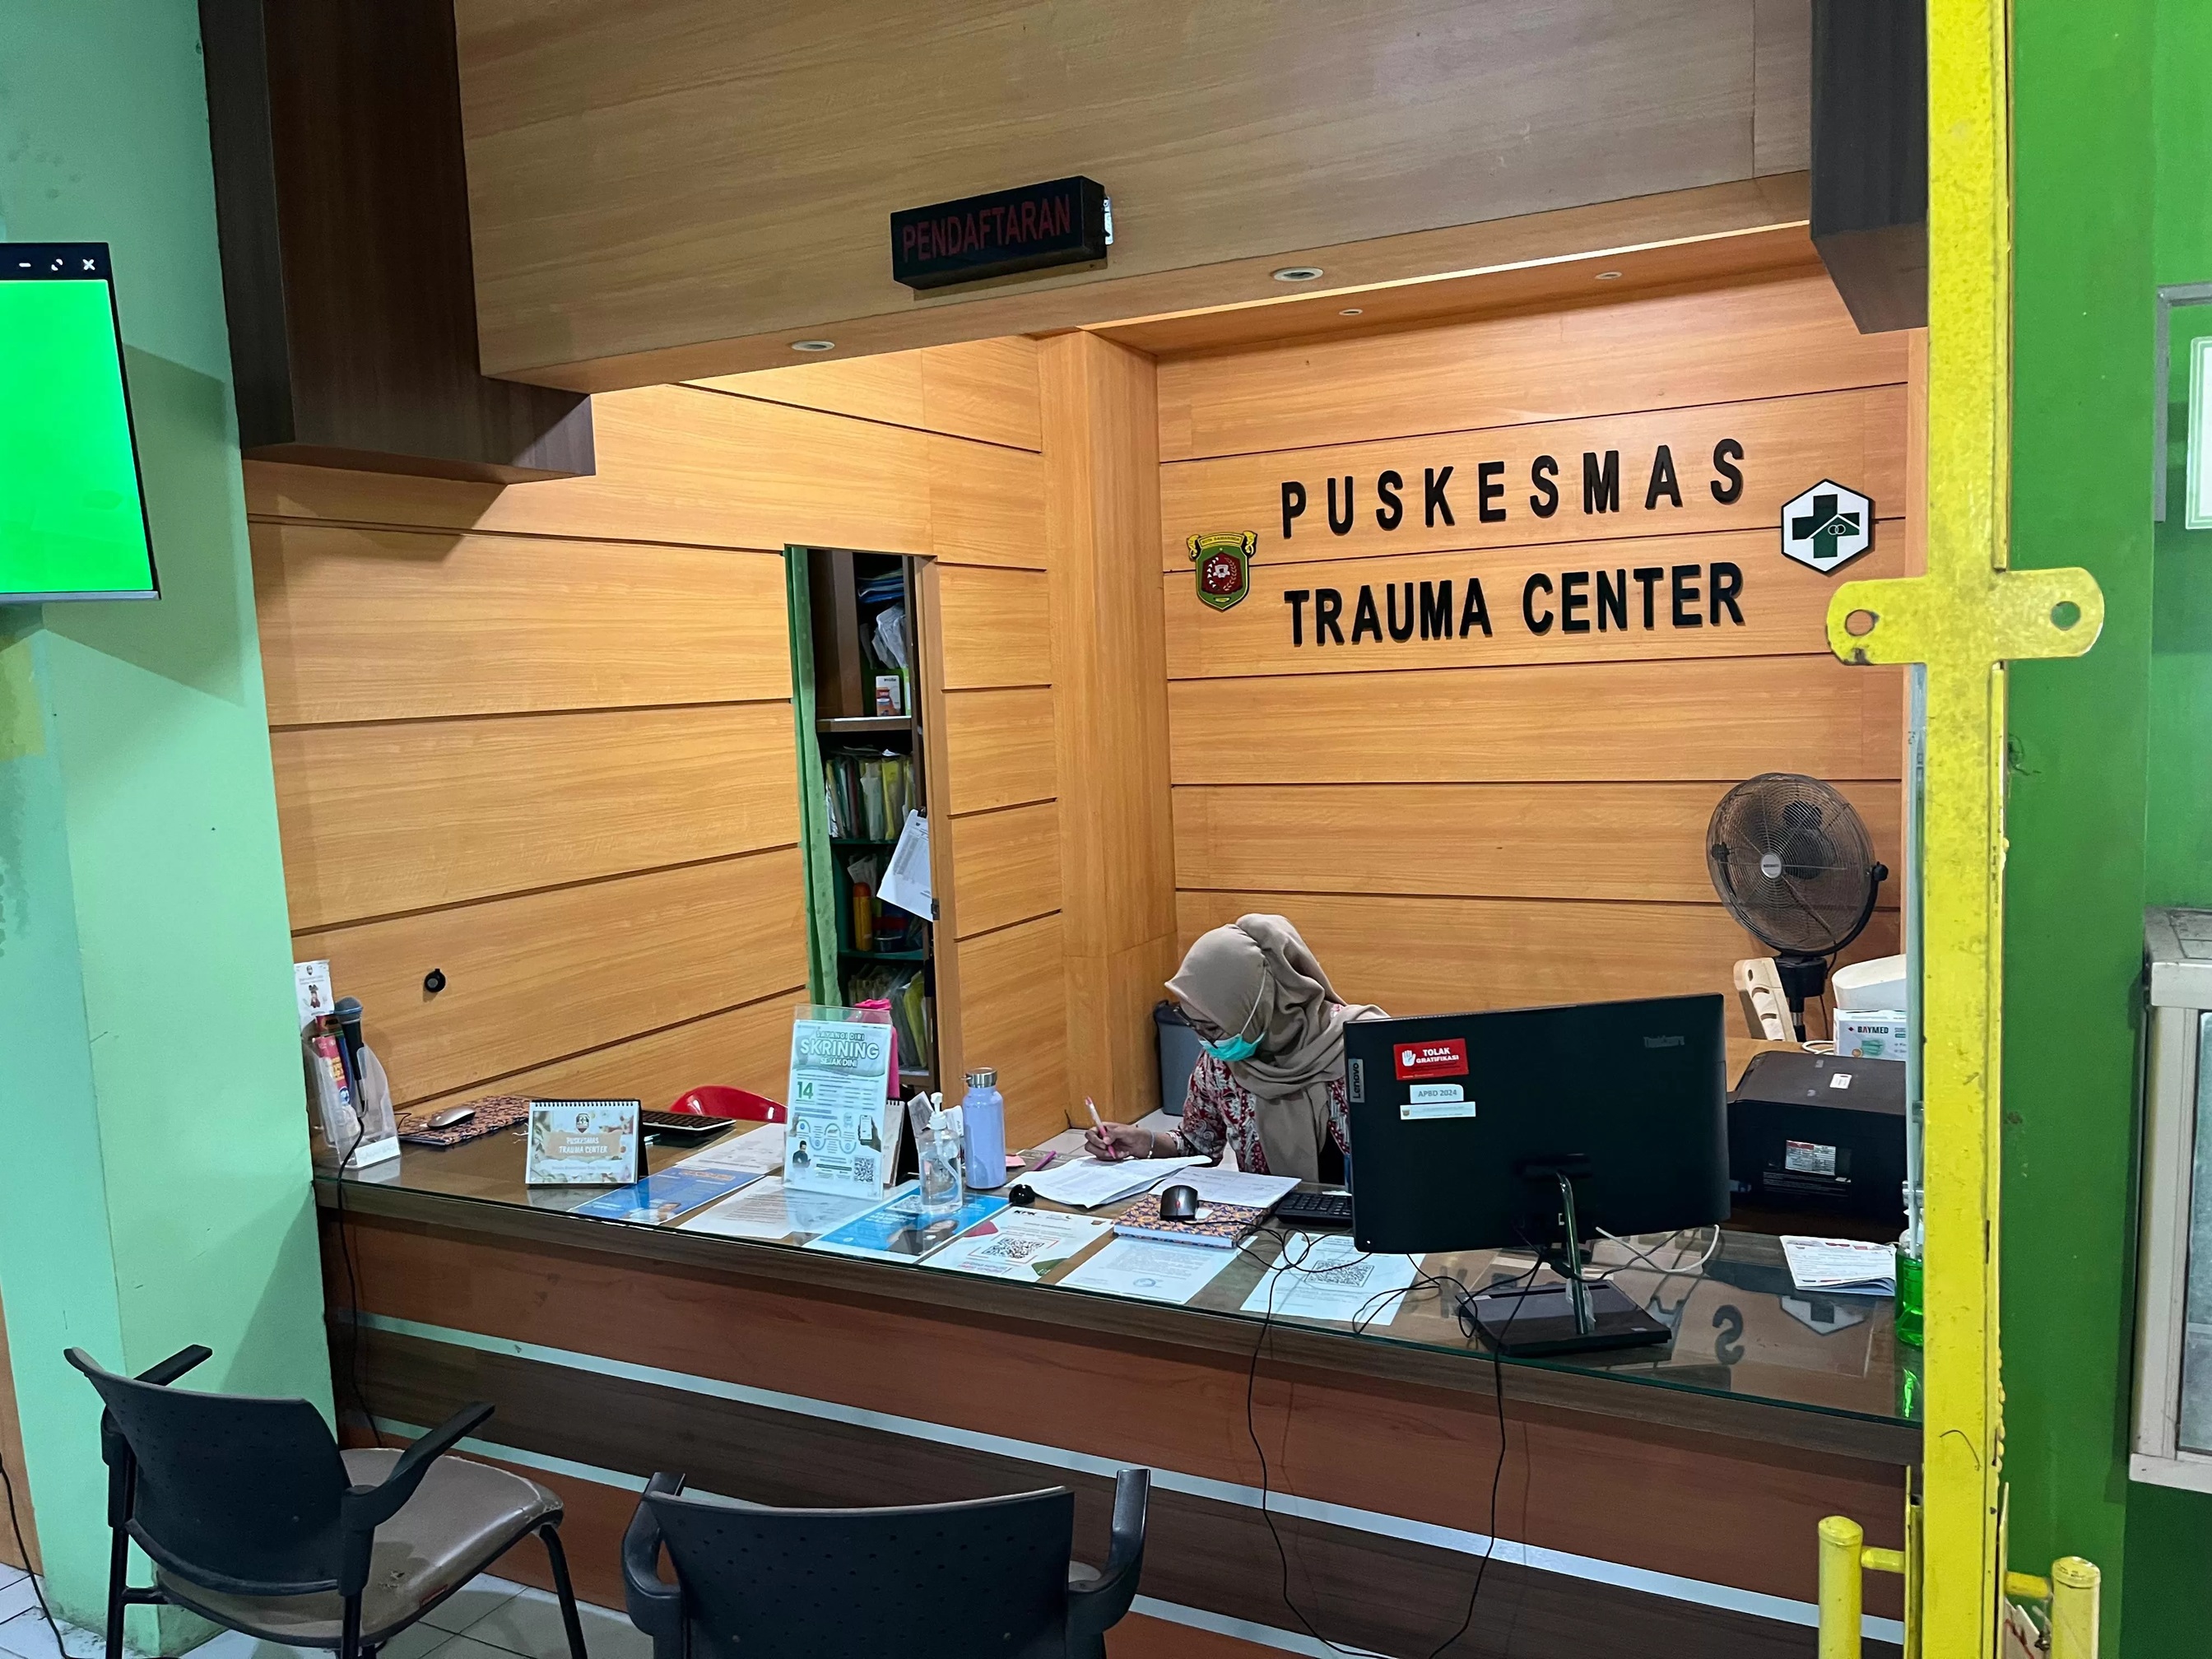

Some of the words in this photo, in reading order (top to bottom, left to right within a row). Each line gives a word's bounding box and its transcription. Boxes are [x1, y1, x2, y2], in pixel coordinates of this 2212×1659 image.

[902, 193, 1070, 263] PENDAFTARAN
[1281, 439, 1745, 539] PUSKESMAS
[1284, 578, 1493, 647] TRAUMA
[1522, 561, 1745, 635] CENTER
[816, 1030, 848, 1040] SAYANGI
[849, 1033, 865, 1041] DIRI
[800, 1038, 880, 1060] SKRINING
[1423, 1048, 1451, 1057] TOLAK
[820, 1057, 842, 1066] SEJAK
[842, 1058, 857, 1067] DINI
[1415, 1055, 1459, 1064] GRATIFIKASI
[1352, 1062, 1361, 1099] Lenovo
[797, 1081, 814, 1099] 14
[559, 1146, 583, 1154] TRAUMA
[585, 1146, 608, 1154] CENTER
